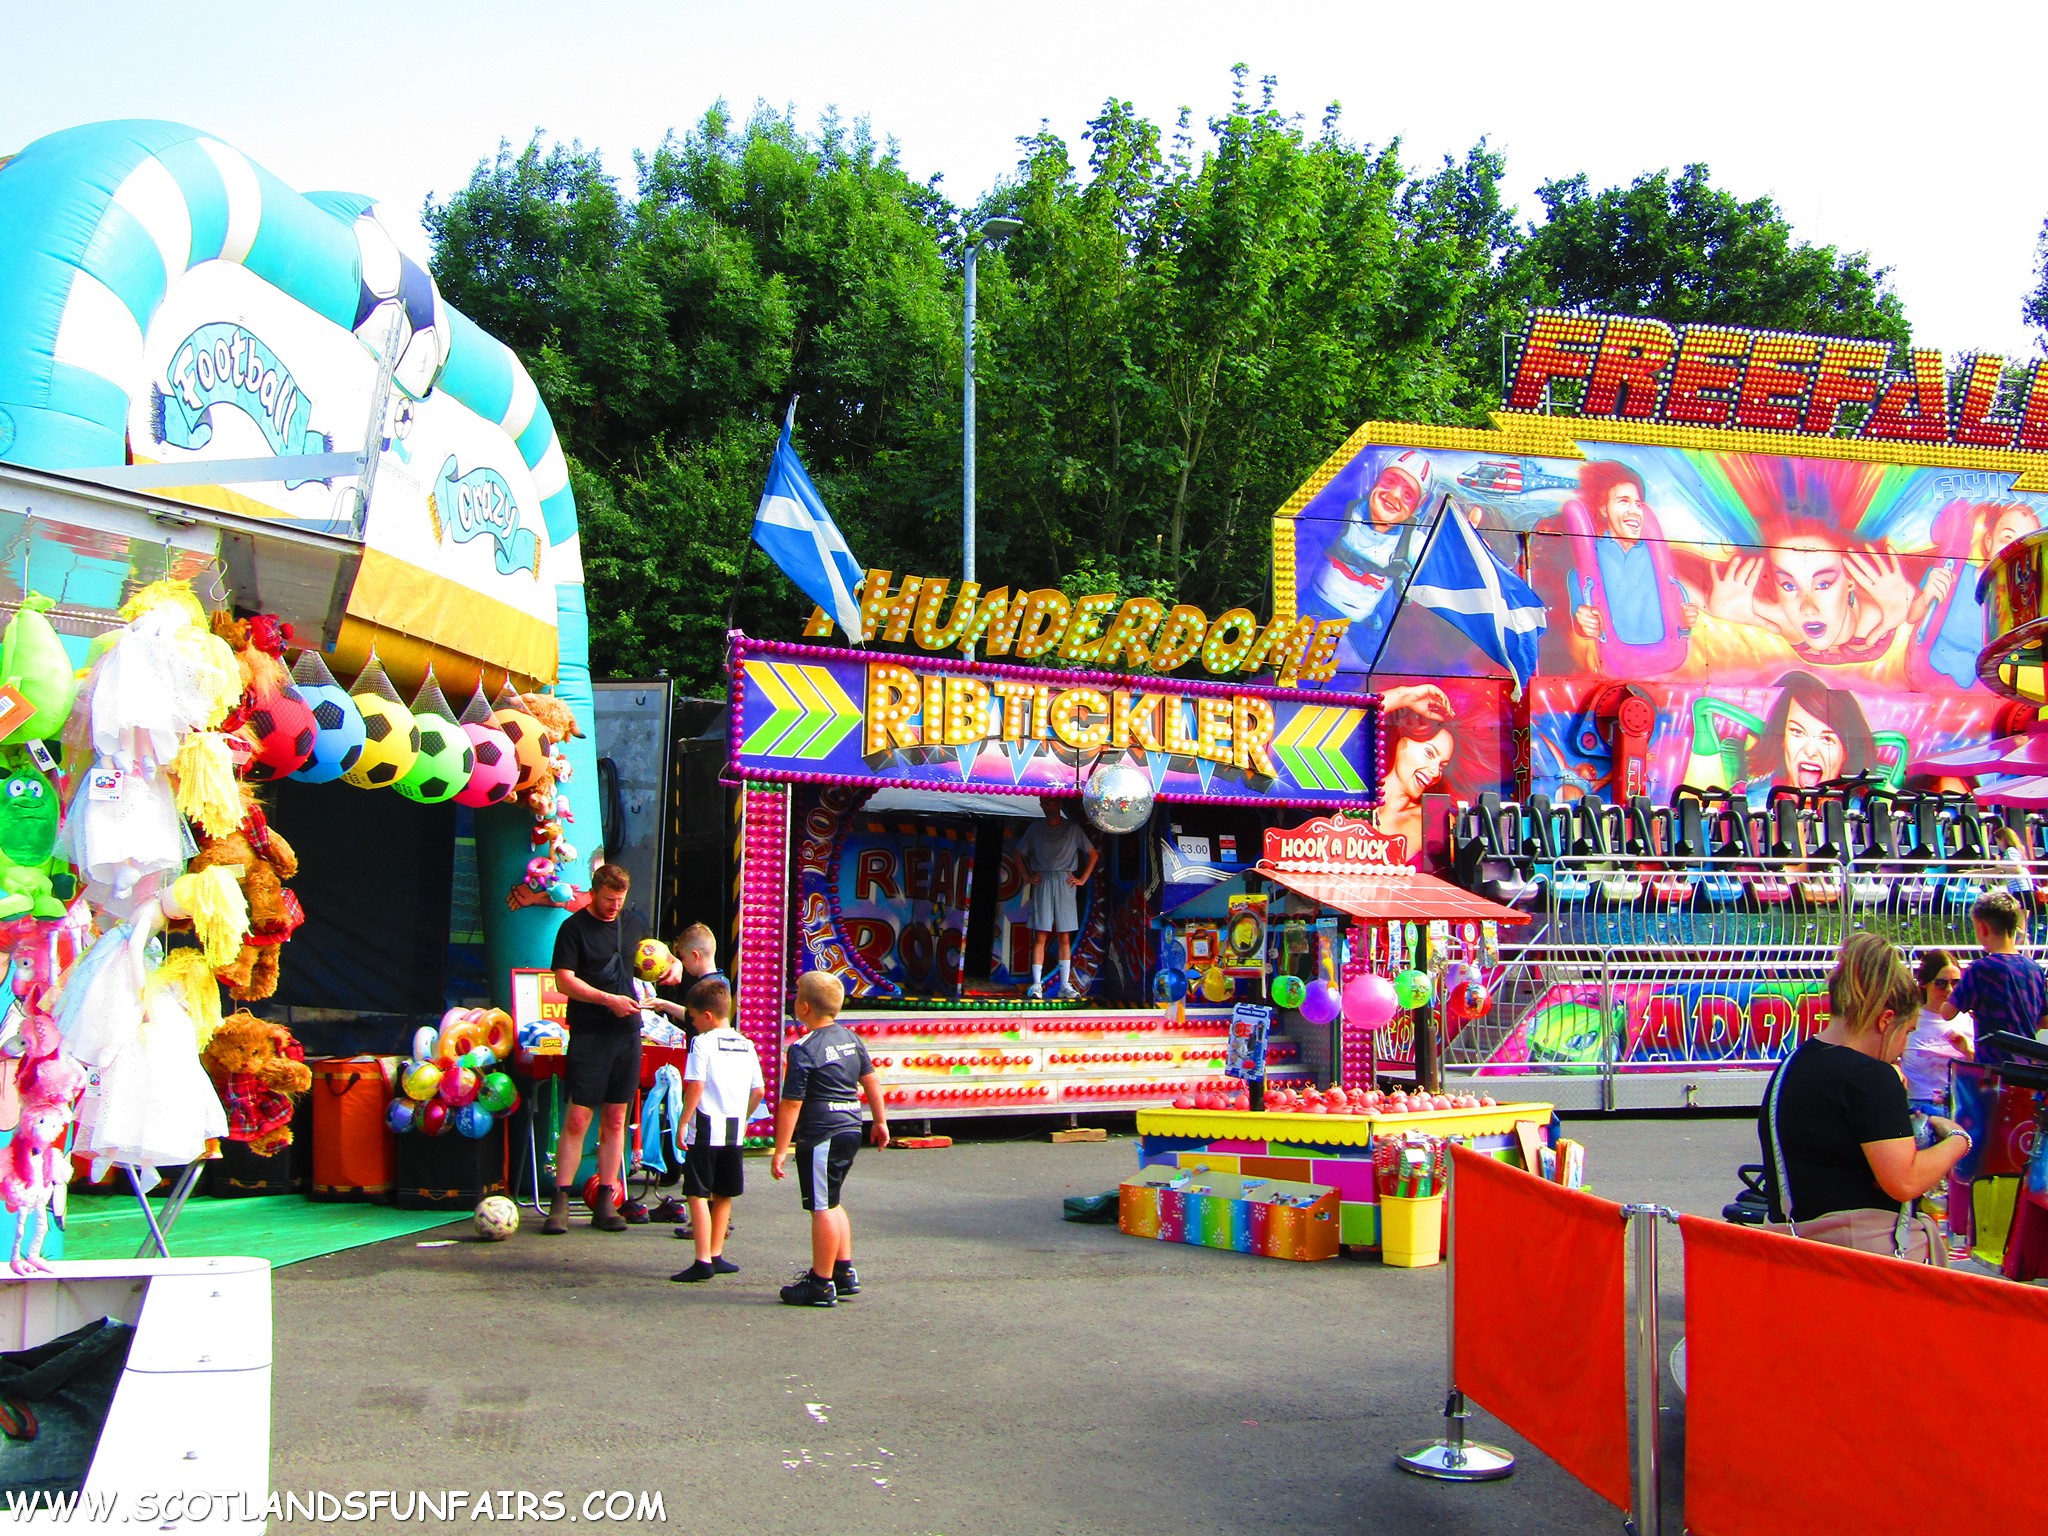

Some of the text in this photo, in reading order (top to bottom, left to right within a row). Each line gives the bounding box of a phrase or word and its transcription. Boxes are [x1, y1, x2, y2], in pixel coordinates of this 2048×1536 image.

[172, 326, 298, 450] Football
[457, 479, 518, 540] Crazy
[1932, 472, 2048, 505] FLYIN
[863, 661, 1279, 780] RIBTICKLER
[1180, 843, 1208, 855] £3.00
[1280, 835, 1390, 865] HOOK A DUCK
